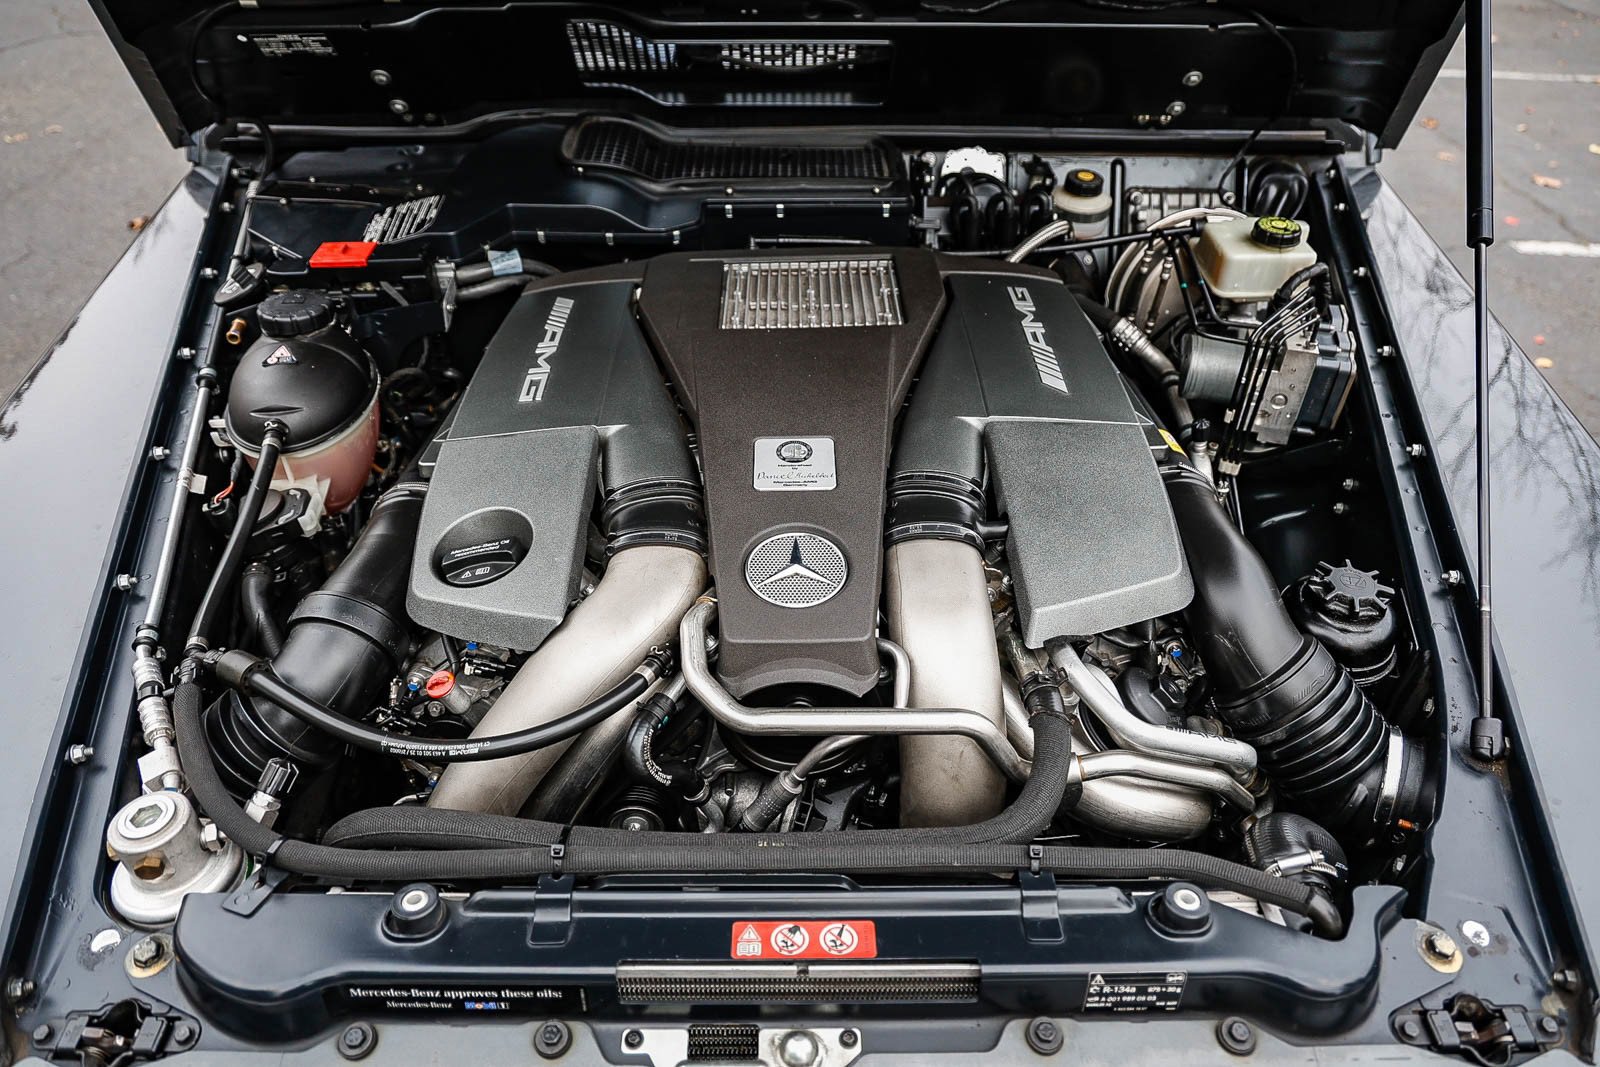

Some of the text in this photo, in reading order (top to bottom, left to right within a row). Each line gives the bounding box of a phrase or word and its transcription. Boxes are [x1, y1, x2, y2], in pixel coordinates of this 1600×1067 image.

[451, 542, 499, 555] Mercedes-Benz
[455, 545, 500, 557] recommended
[349, 988, 563, 999] Mercedes-Benz approves these oils:
[386, 1000, 453, 1009] Mercedes-Benz
